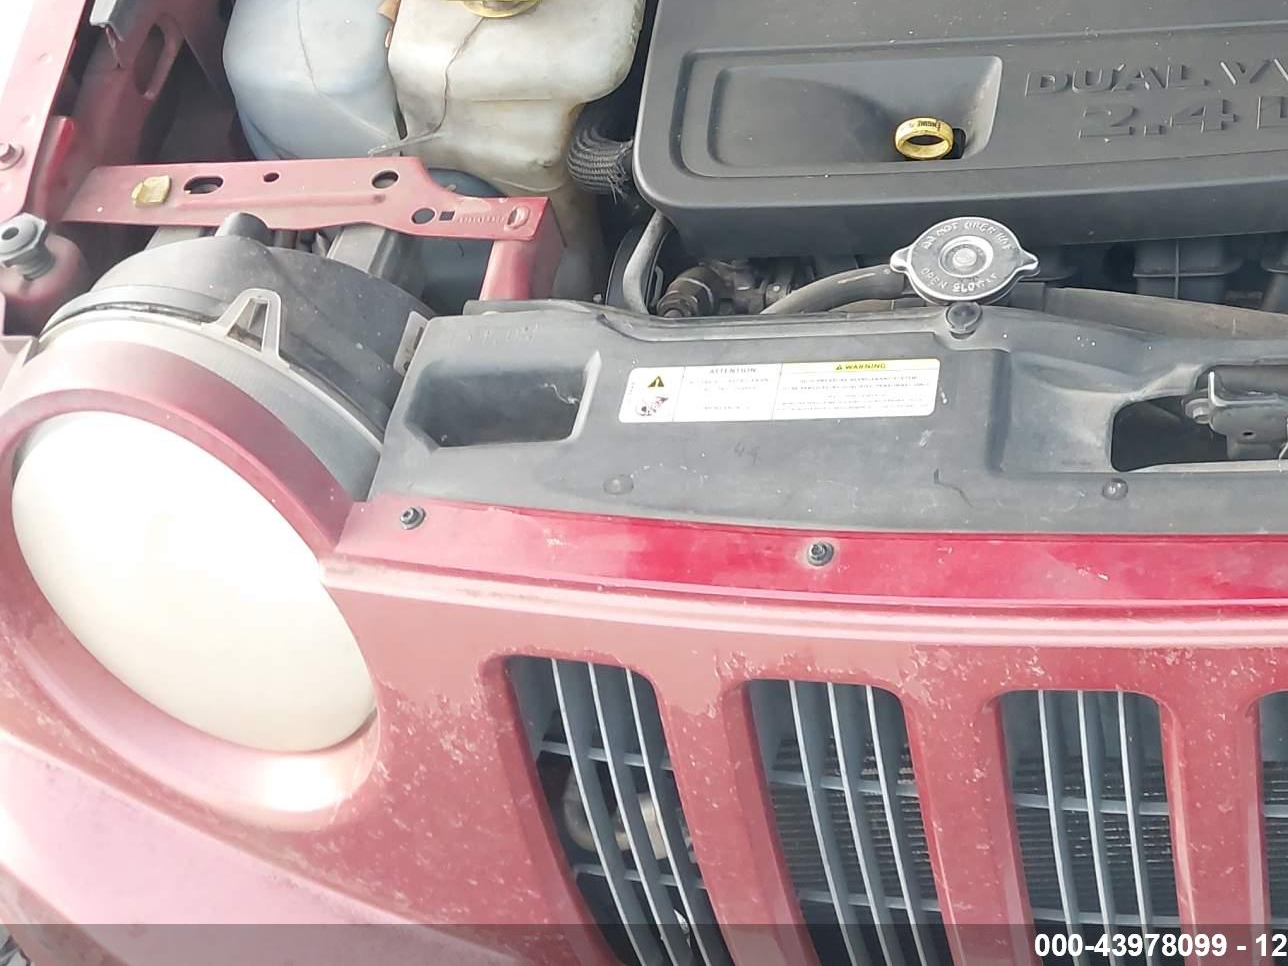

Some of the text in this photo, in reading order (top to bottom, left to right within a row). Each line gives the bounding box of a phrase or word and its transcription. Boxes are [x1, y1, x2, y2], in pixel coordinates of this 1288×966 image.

[1025, 62, 1211, 96] DUAL
[936, 222, 960, 236] NOT
[919, 267, 949, 290] OPEN
[844, 362, 887, 370] WARNING
